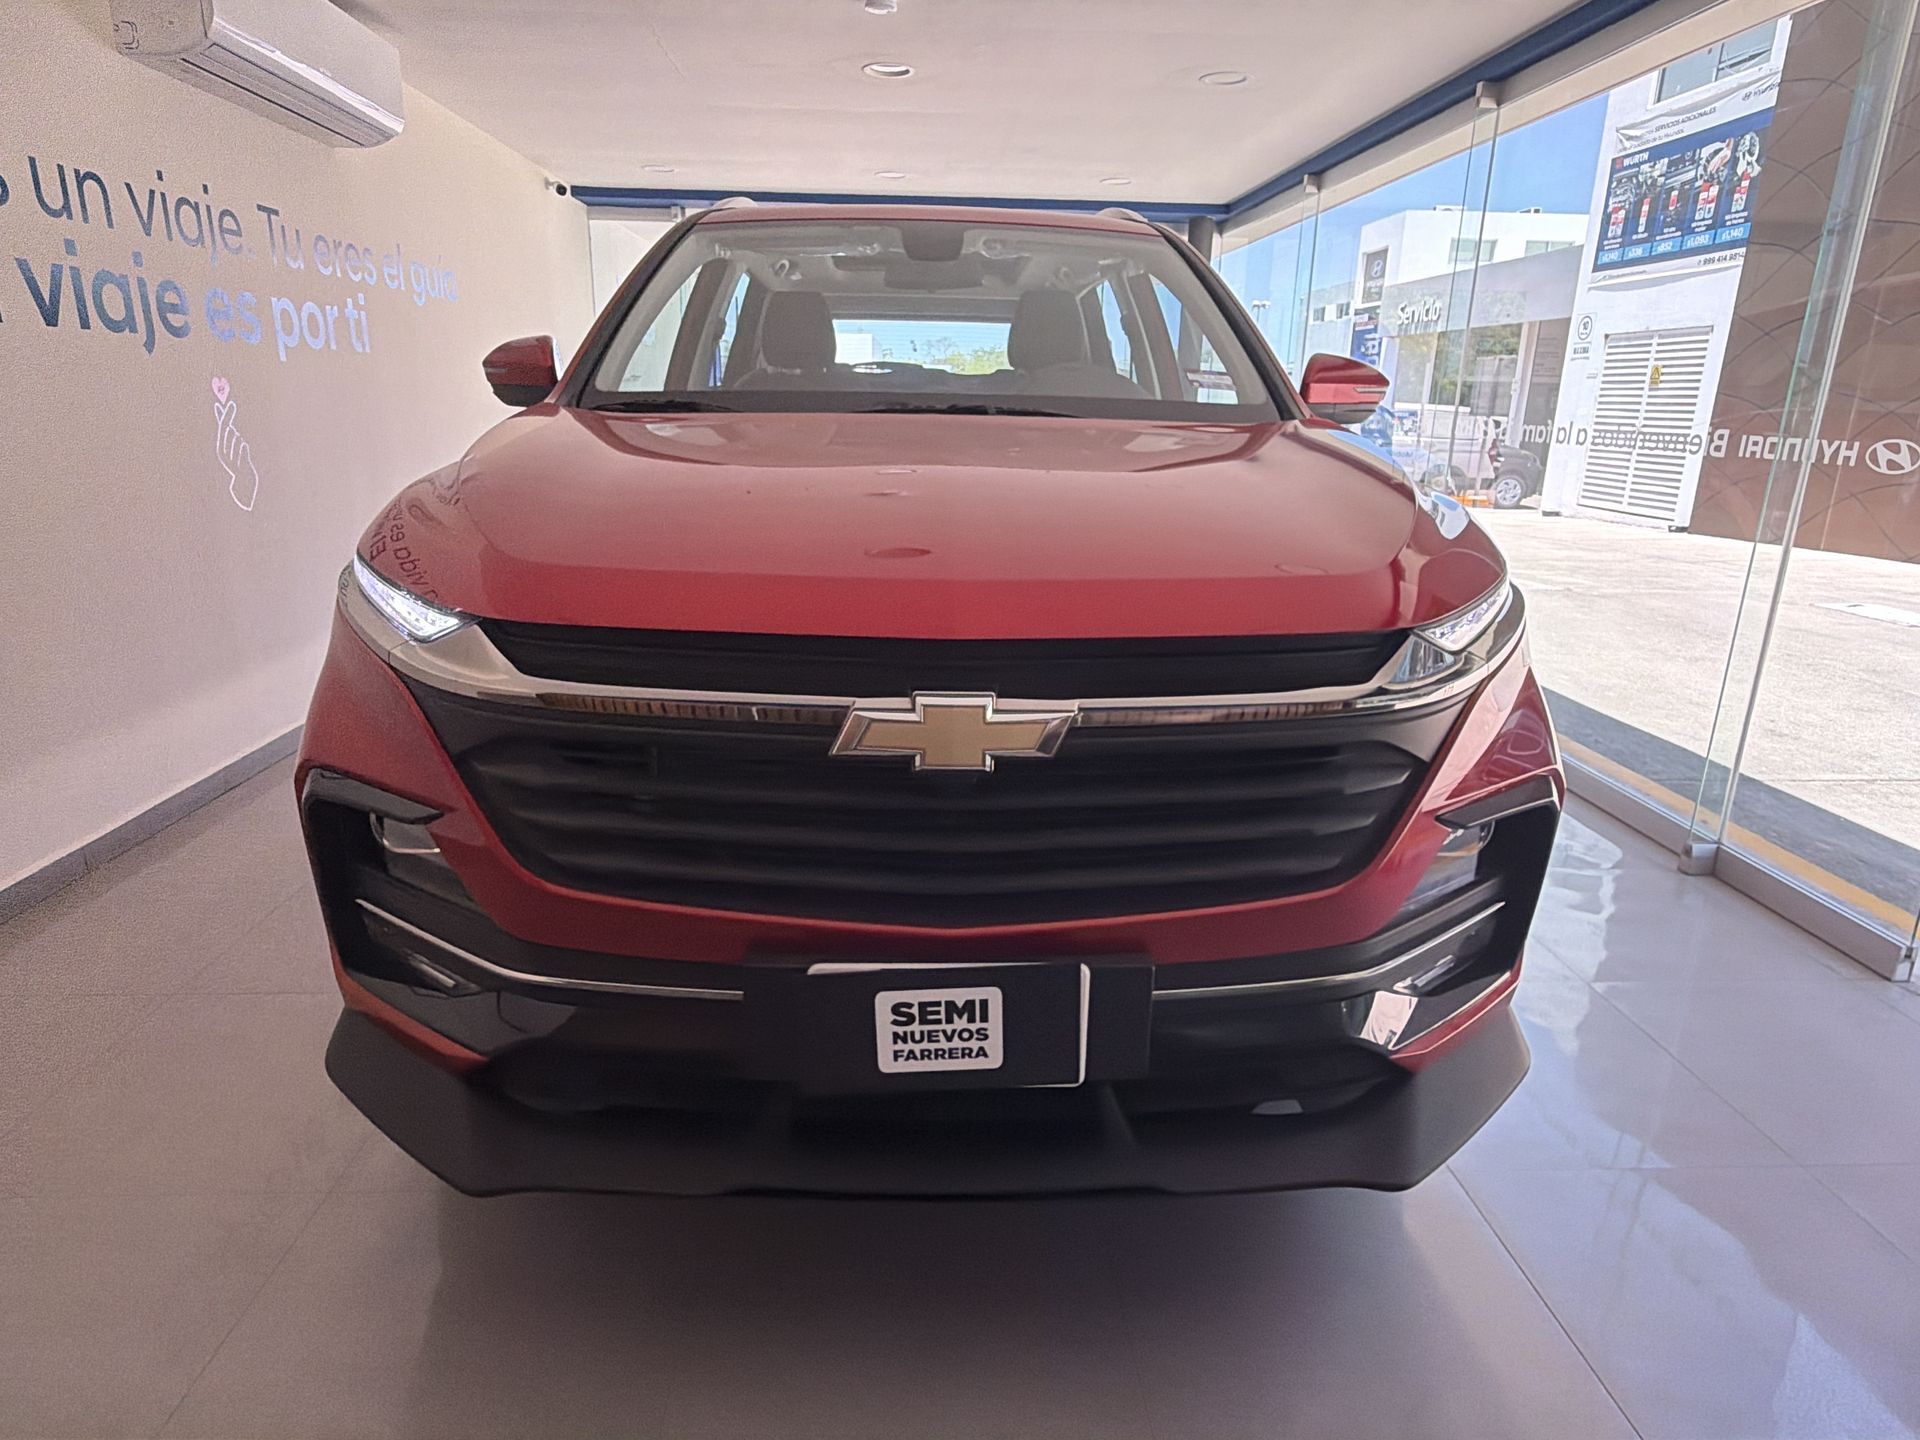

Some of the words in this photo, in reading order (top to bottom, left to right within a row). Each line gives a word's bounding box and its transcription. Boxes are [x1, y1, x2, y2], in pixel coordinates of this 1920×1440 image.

[27, 155, 115, 230] un
[124, 170, 257, 266] viaje.
[256, 203, 304, 270] Tu
[313, 234, 377, 286] eres
[382, 243, 405, 290] el
[15, 239, 191, 357] viaje
[205, 288, 262, 345] es
[271, 296, 338, 362] por
[345, 292, 371, 353] ti
[1397, 299, 1441, 325] Servicio
[890, 998, 989, 1027] SEMI
[892, 1027, 989, 1045] NUEVOS
[893, 1046, 989, 1062] FARRERA
